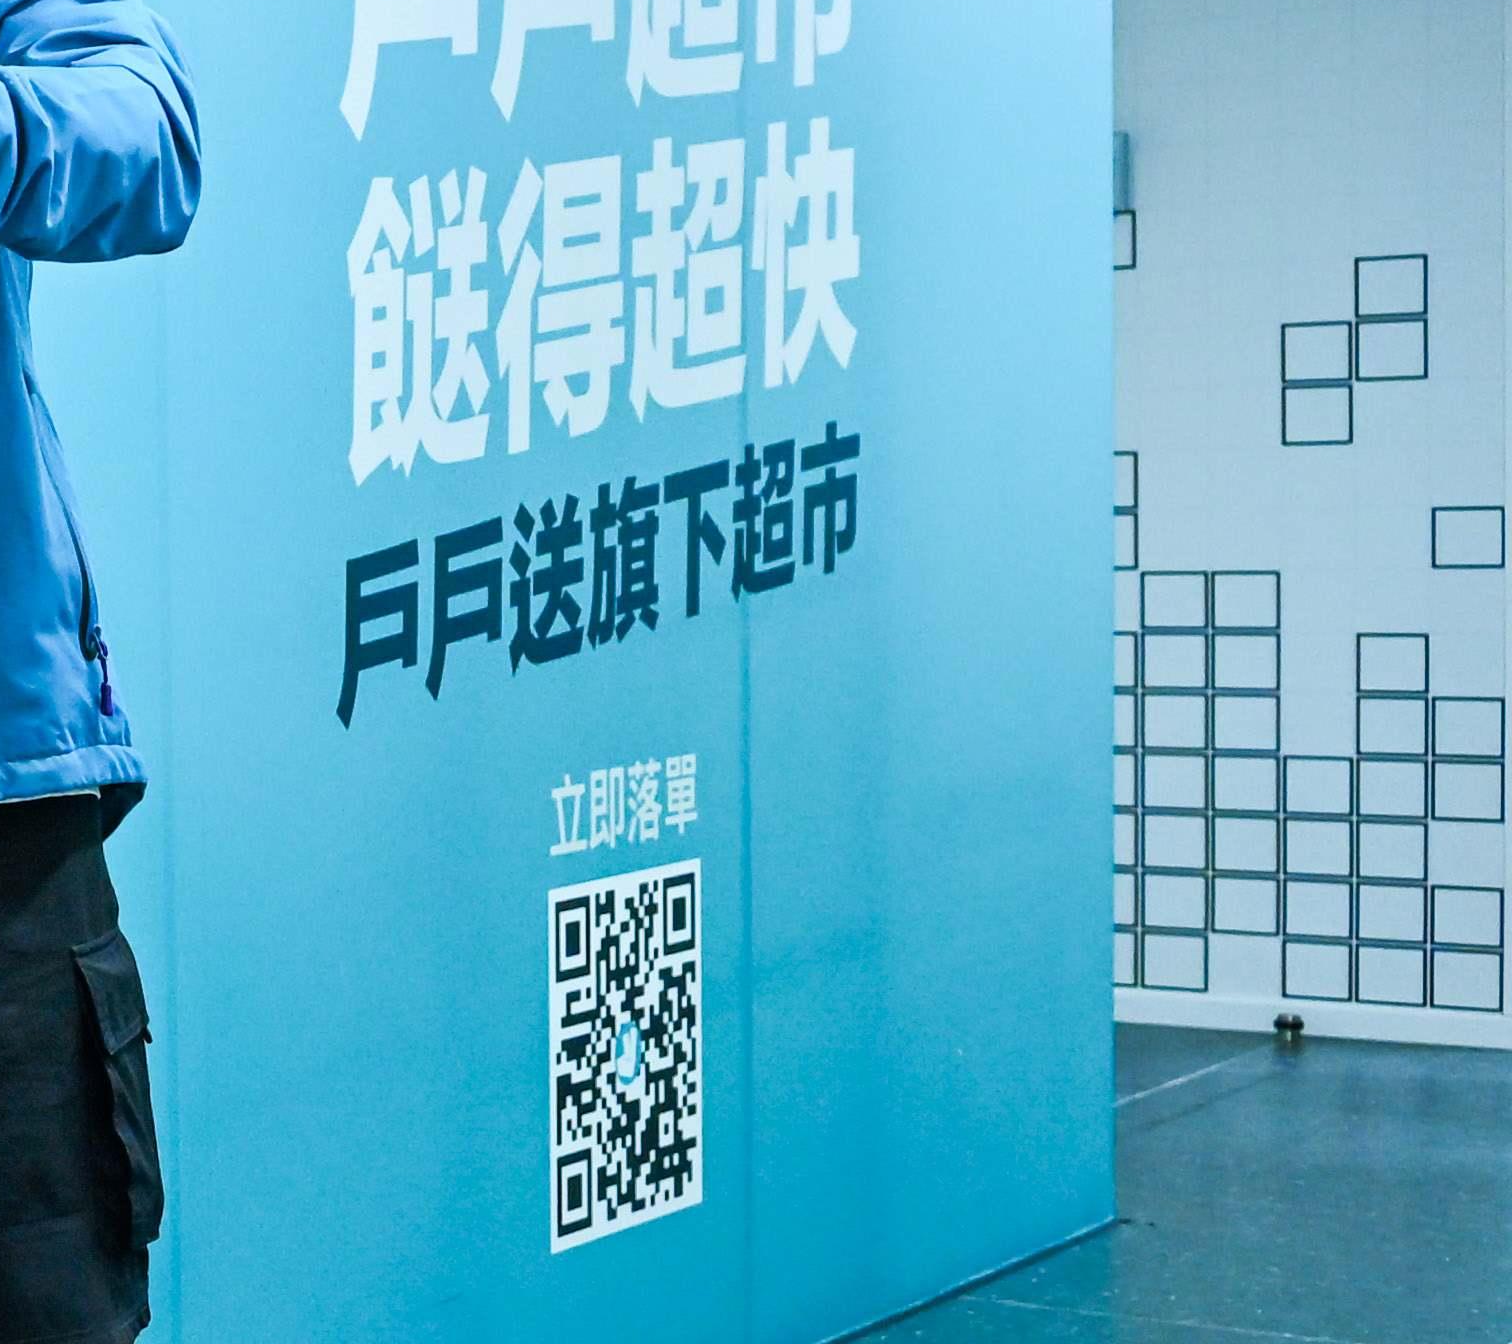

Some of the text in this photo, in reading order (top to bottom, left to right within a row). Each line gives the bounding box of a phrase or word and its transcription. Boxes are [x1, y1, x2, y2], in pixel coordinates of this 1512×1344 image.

[347, 116, 860, 487] 餸得超快
[336, 421, 861, 731] 戶戶送旗下超市
[549, 753, 698, 857] 立即落單
